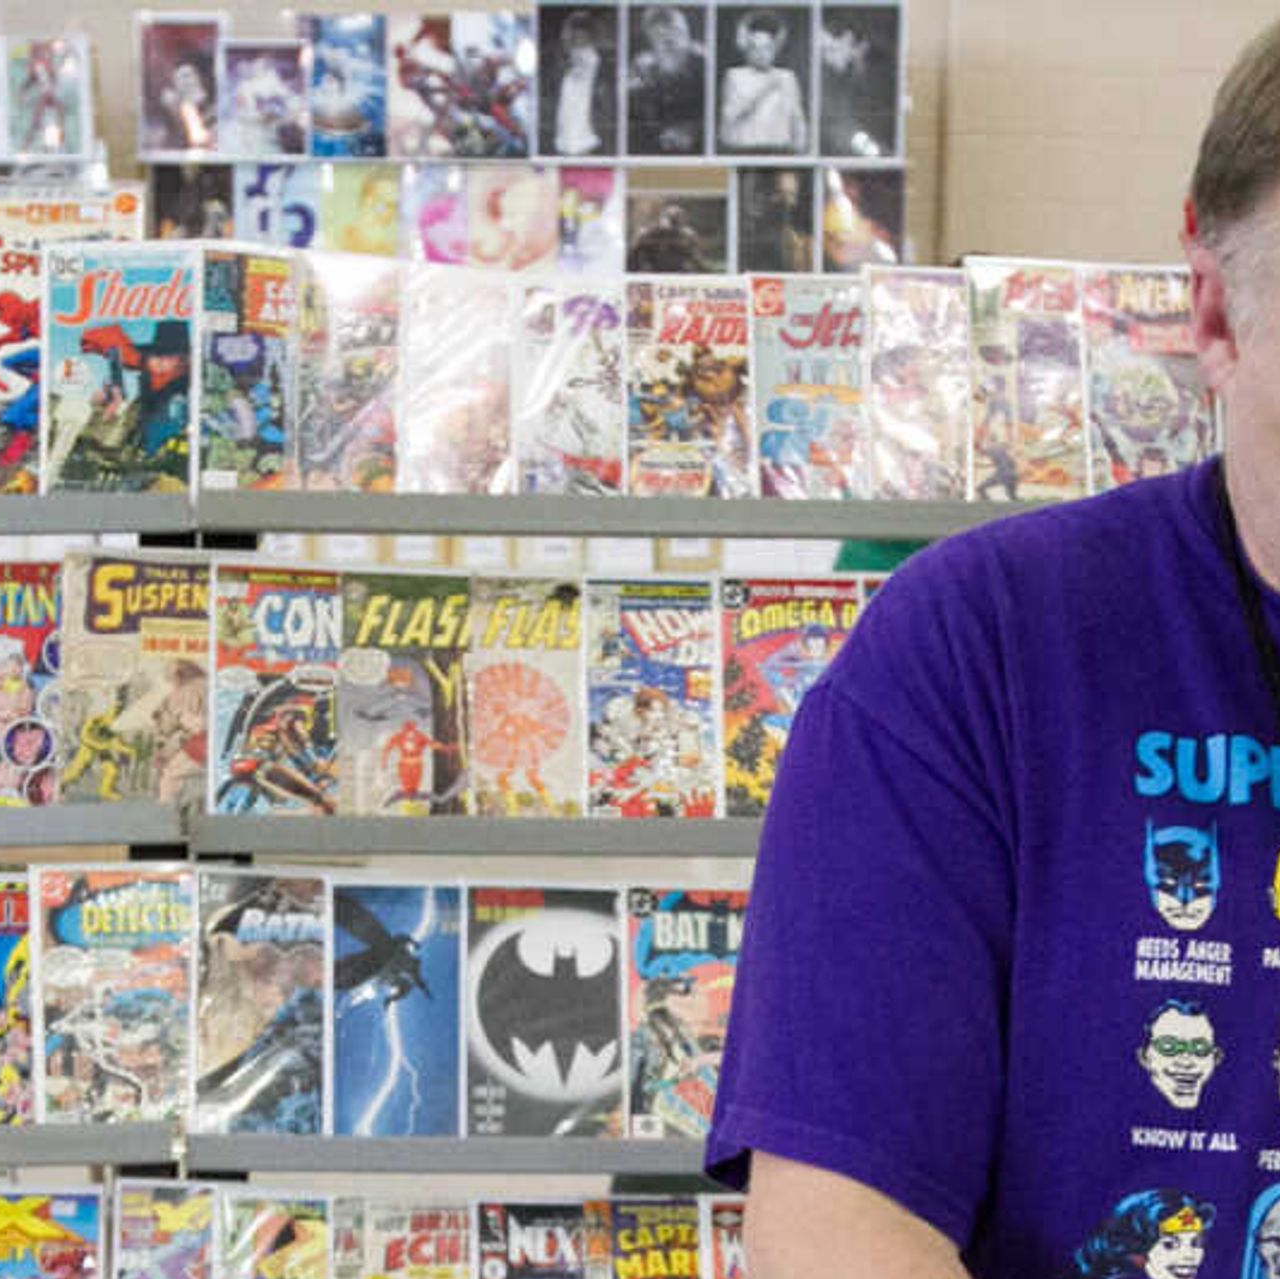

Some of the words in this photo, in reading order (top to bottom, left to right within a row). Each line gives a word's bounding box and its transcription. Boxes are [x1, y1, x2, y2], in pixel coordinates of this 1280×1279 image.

[1134, 960, 1232, 986] MANAGEMENT
[1131, 1127, 1184, 1150] KNOW
[1189, 1130, 1205, 1150] IT
[1208, 1129, 1238, 1152] ALL
